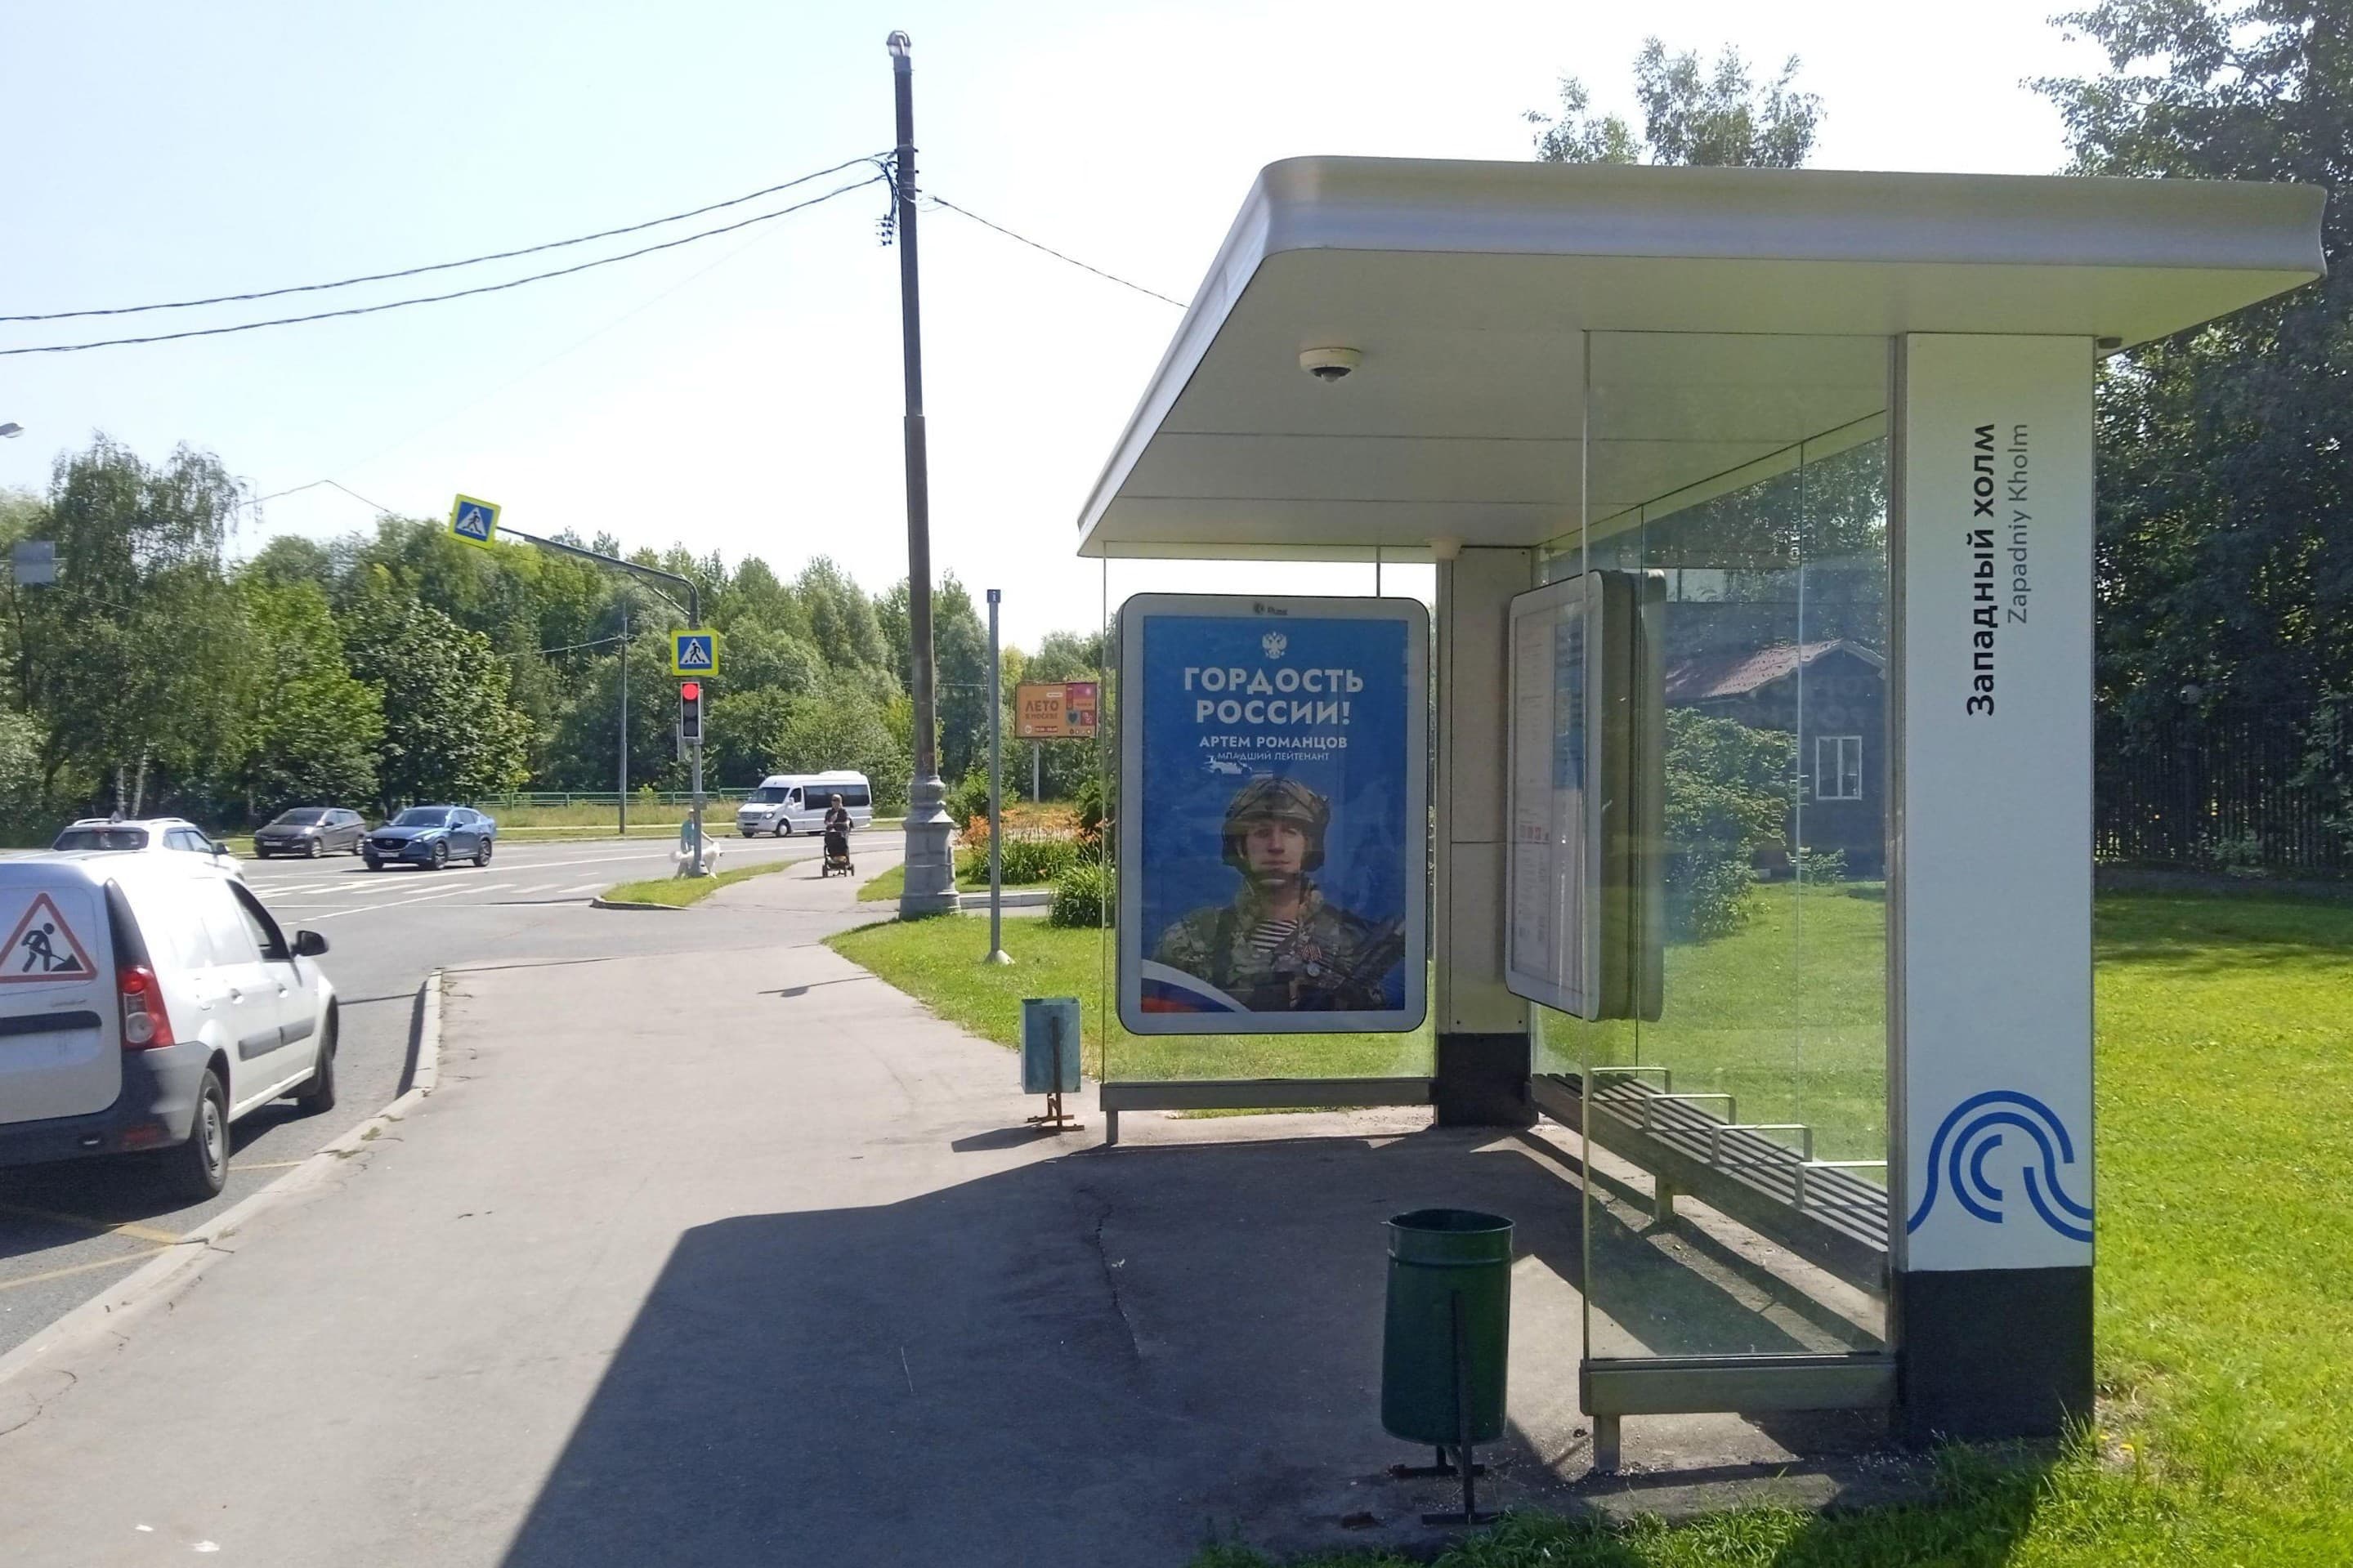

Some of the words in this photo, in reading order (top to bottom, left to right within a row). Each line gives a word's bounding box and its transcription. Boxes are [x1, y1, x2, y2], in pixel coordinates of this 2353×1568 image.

[1973, 423, 1994, 517] холм
[2006, 423, 2028, 502] Kholm
[2007, 508, 2032, 624] Zapadniy
[1966, 529, 1998, 717] Западный
[1184, 666, 1364, 695] ГОРДОСТЬ
[1025, 700, 1059, 712] ЛЕТО
[1196, 699, 1350, 725] РОССИИ!
[1199, 735, 1250, 748] АРТЕМ
[1256, 736, 1348, 750] РОМАНЦОВ
[1274, 750, 1330, 762] ЛЕЙТЕНАНТ
